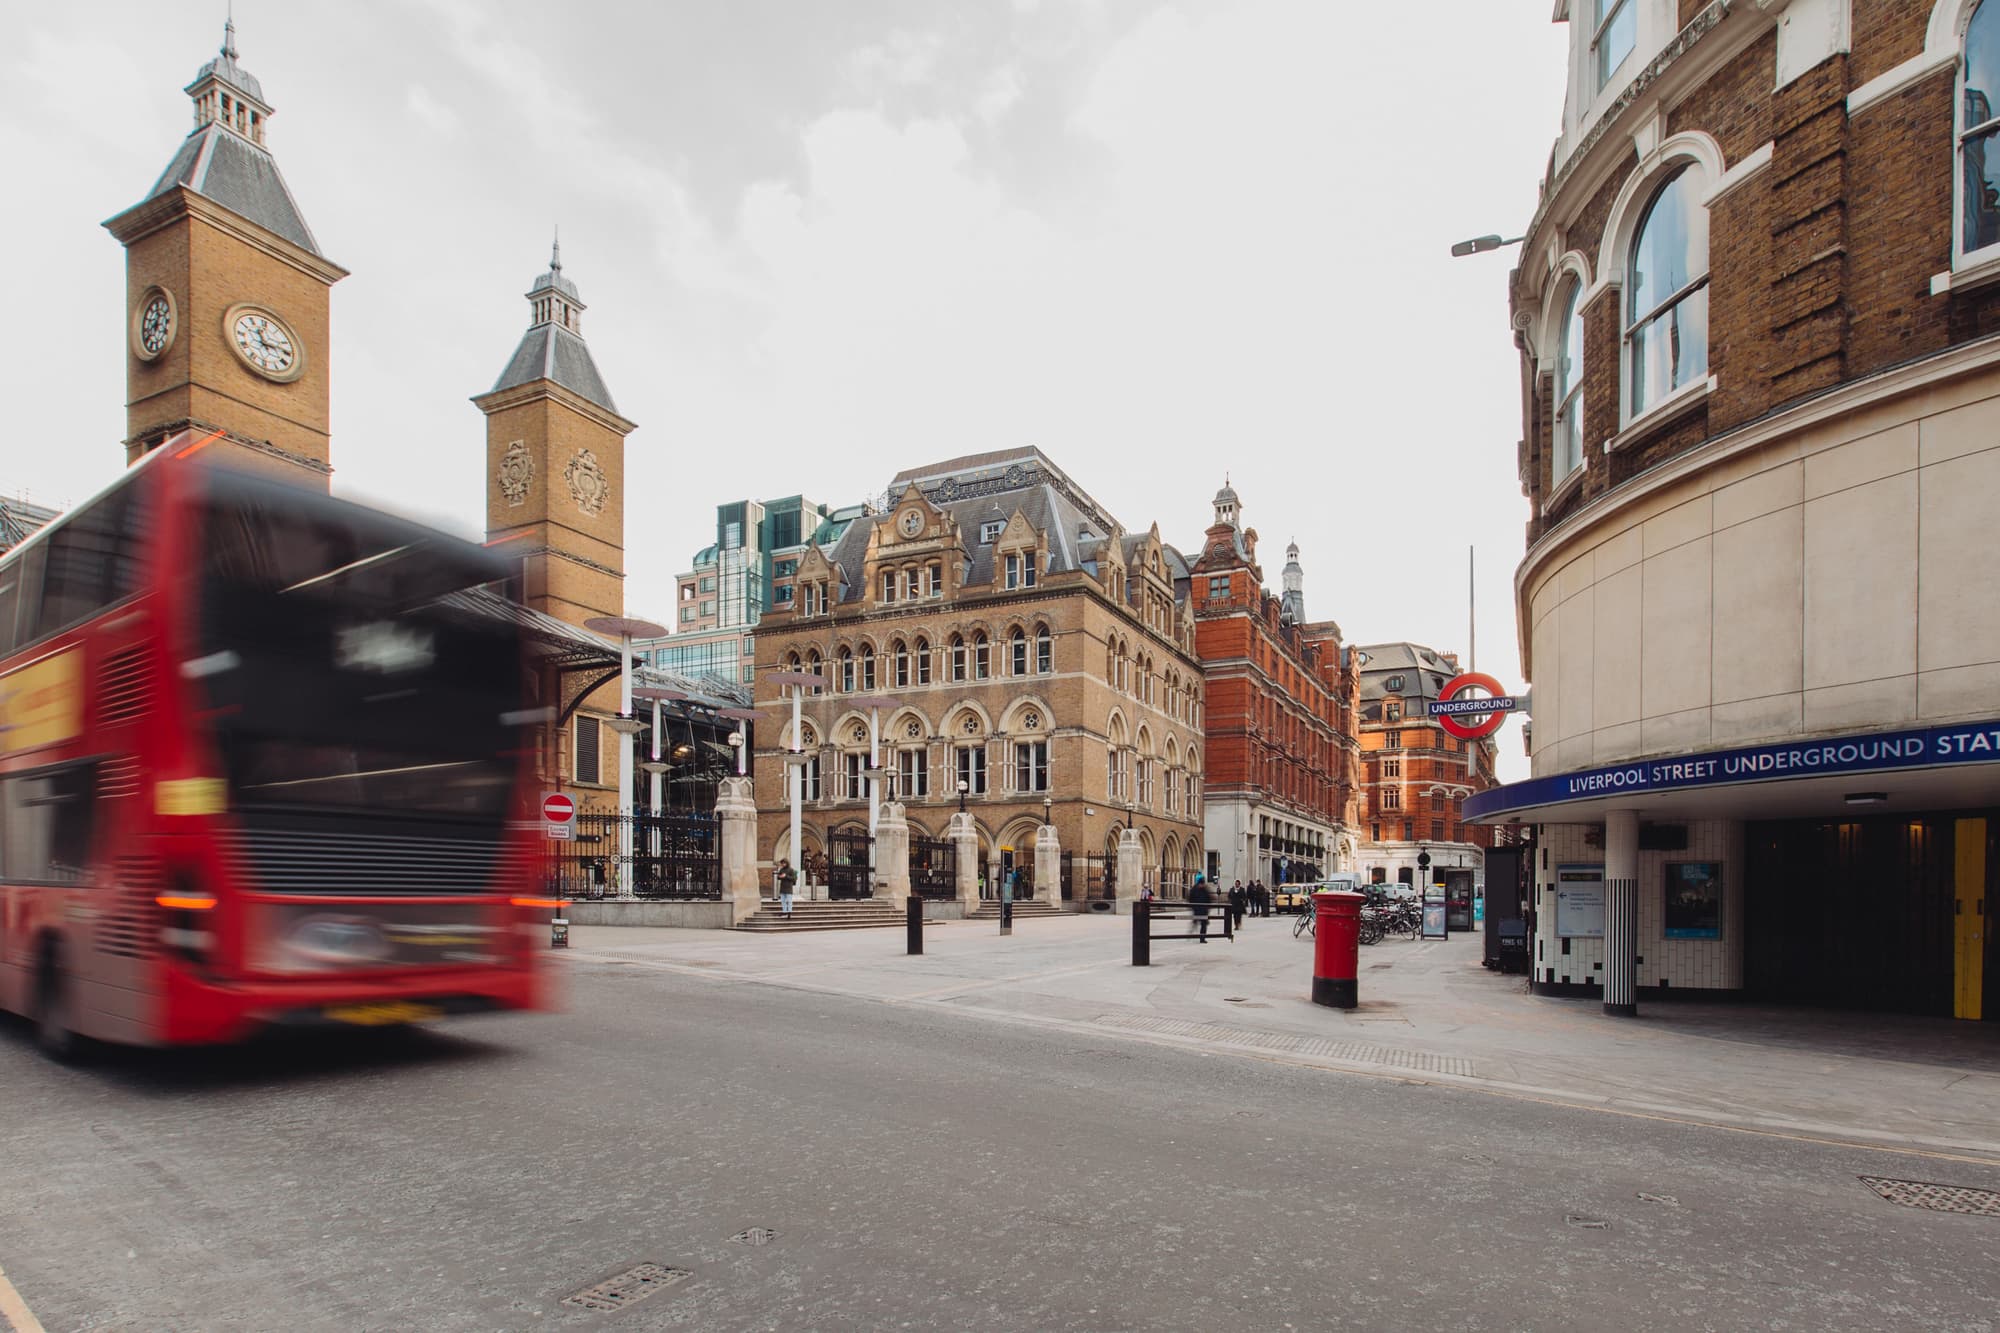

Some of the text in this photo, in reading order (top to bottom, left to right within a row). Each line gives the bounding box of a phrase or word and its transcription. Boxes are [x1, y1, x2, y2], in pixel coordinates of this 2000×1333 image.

[1431, 699, 1513, 713] UNDERGROUND
[1570, 768, 1647, 793] LIVERPOOL
[1652, 760, 1718, 782] STREET
[1724, 738, 1925, 775] UNDERGROUND
